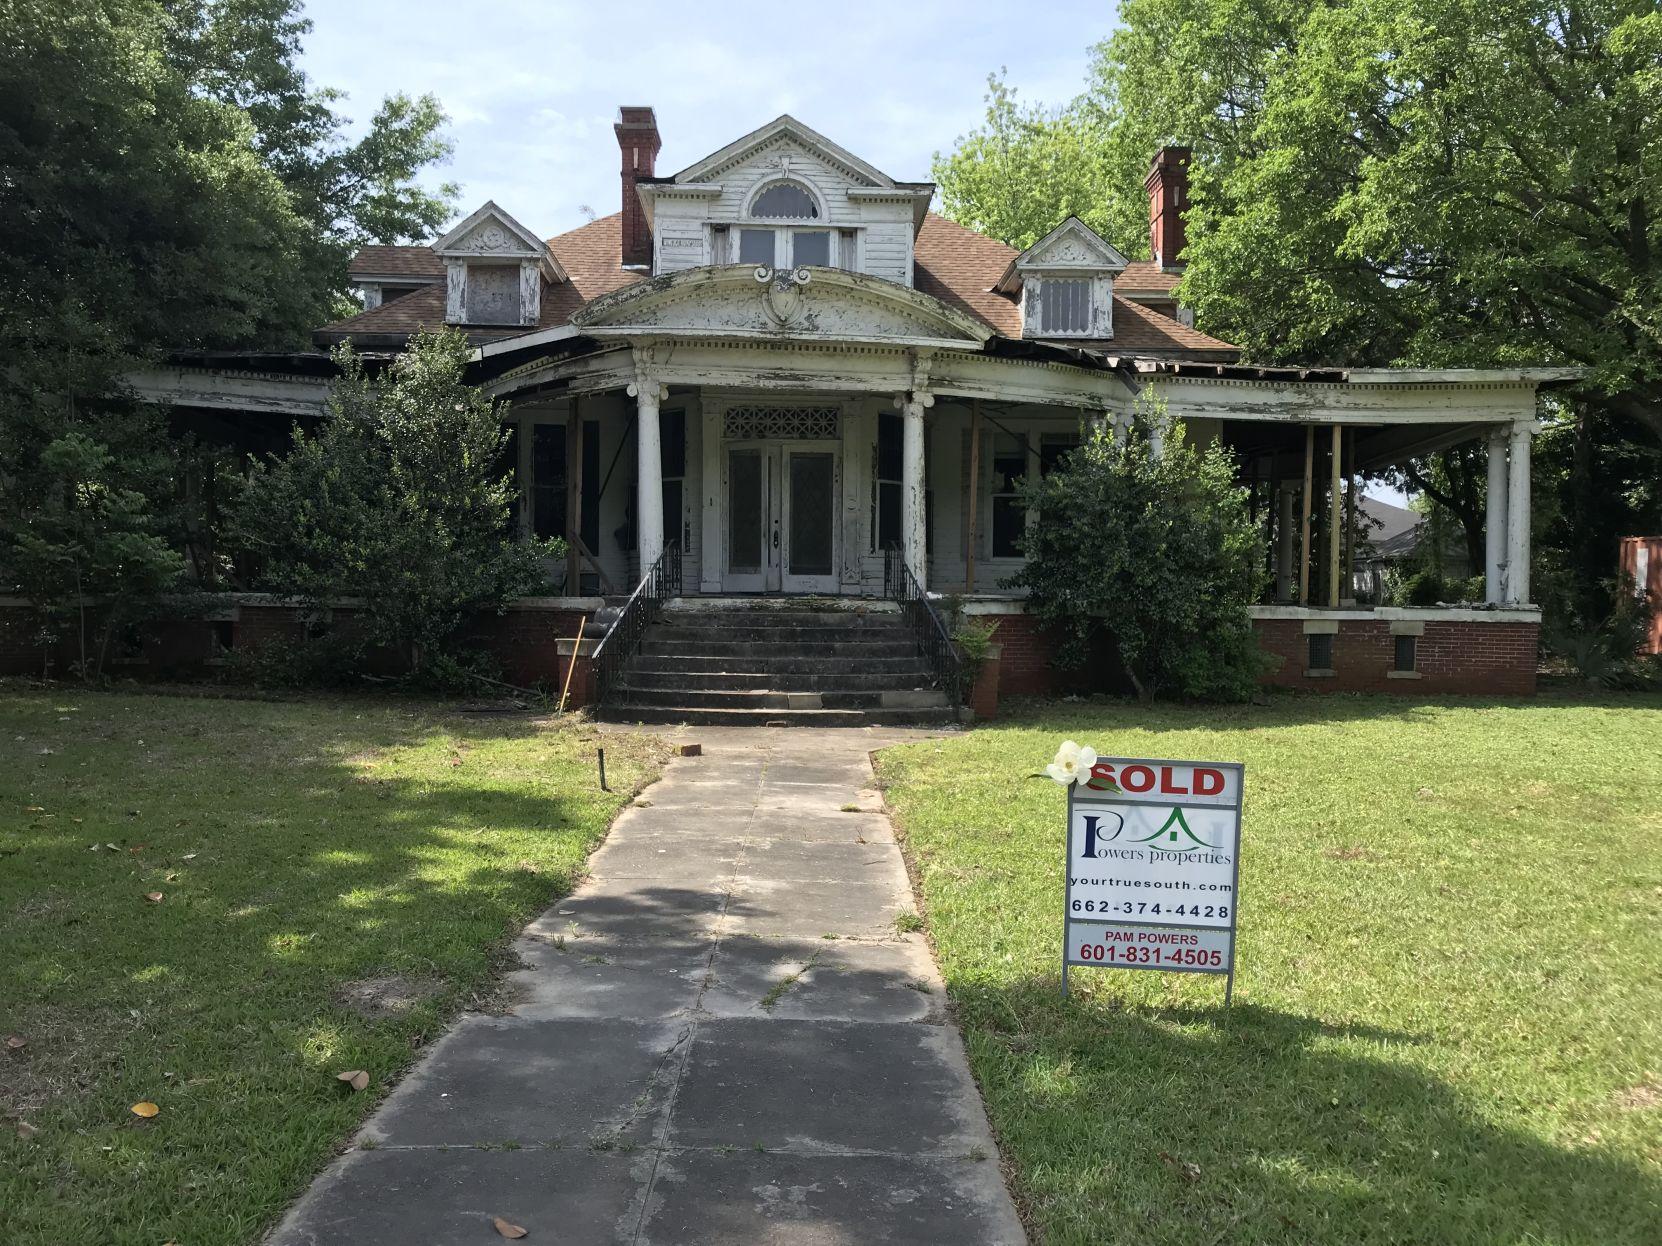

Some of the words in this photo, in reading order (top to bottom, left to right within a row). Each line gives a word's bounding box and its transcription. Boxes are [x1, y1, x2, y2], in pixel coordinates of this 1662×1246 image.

[1087, 763, 1226, 796] SOLD
[1149, 848, 1232, 867] properties
[1070, 878, 1232, 892] yourtruesouth.com
[1072, 899, 1229, 919] 662-374-4428
[1105, 931, 1134, 943] PAM
[1138, 933, 1199, 946] POWERS
[1080, 944, 1222, 967] 601-831-4505
